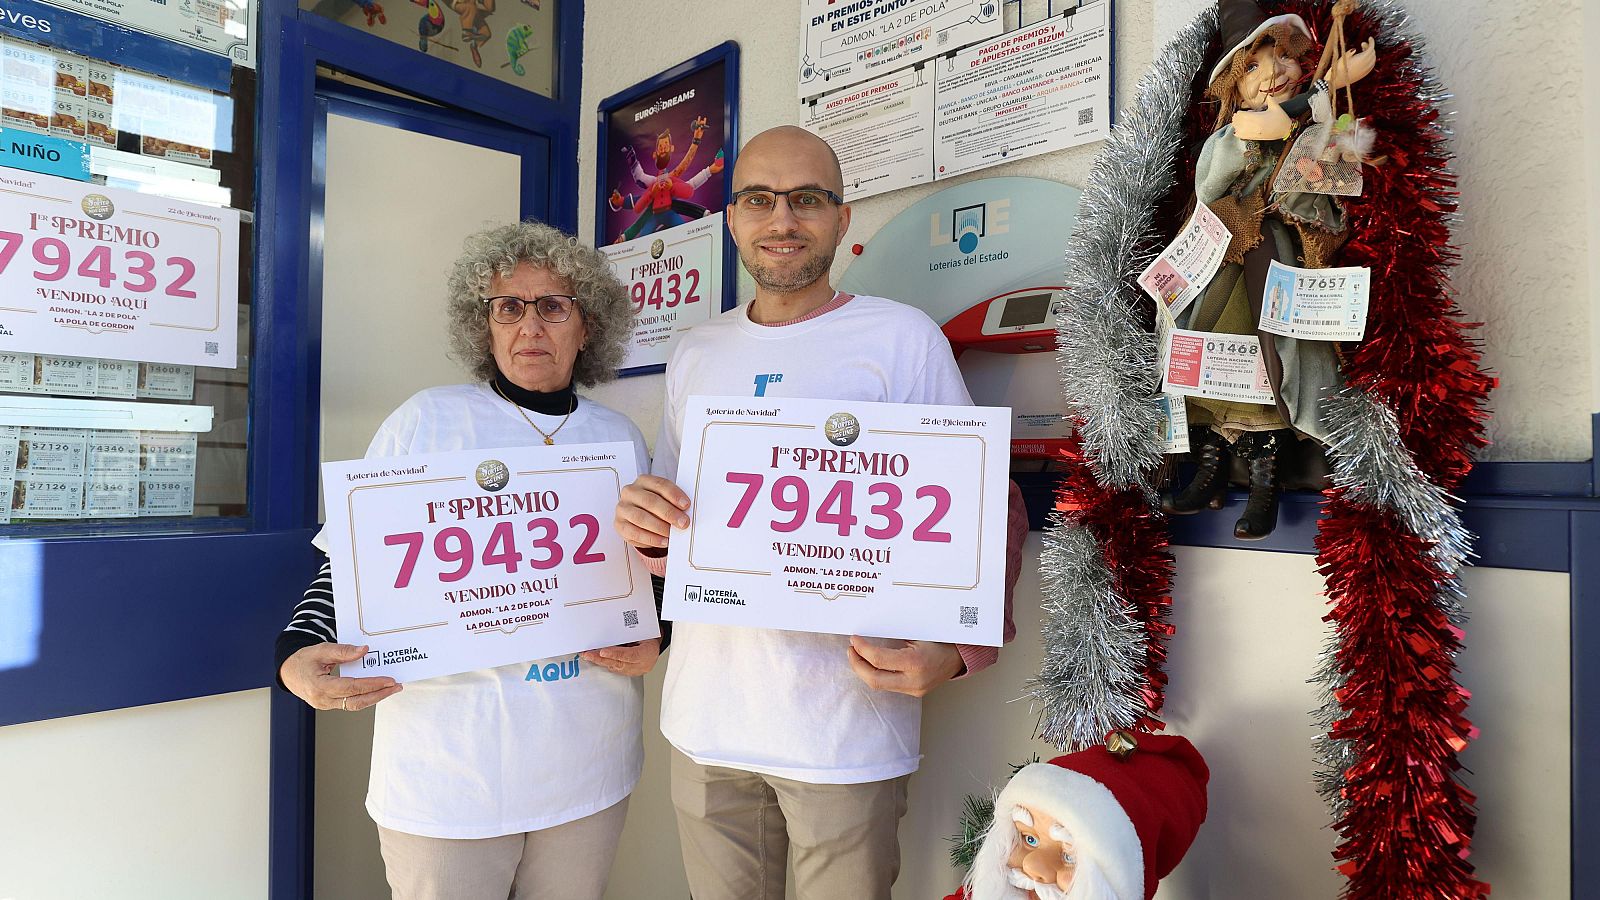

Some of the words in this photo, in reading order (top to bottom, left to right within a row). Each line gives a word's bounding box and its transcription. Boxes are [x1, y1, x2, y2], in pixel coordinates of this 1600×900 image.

[94, 4, 120, 15] GORDON
[812, 15, 825, 26] EN
[828, 0, 873, 21] PREMIOS
[831, 20, 844, 32] EN
[848, 11, 871, 26] ESTE
[874, 0, 906, 18] PUNTO
[841, 29, 876, 47] ADMON.
[880, 22, 894, 33] "LA
[897, 19, 902, 27] 2
[904, 12, 916, 24] DE
[970, 59, 980, 68] DE
[981, 45, 1019, 64] APUESTAS
[1022, 41, 1035, 51] con
[1037, 30, 1064, 45] BIZUM
[978, 43, 998, 56] PAGO
[1001, 39, 1010, 48] DE
[1012, 26, 1048, 44] PREMIOS
[960, 93, 978, 103] BANCO
[1045, 64, 1069, 77] CAJASUR
[1074, 55, 1102, 68] IBERCAJA
[1001, 88, 1020, 98] BANCO
[1021, 77, 1053, 92] SANTANDER
[1060, 66, 1092, 80] BANKINTER
[634, 107, 654, 122] EURO
[662, 88, 696, 110] DREAMS
[825, 99, 843, 110] AVISO
[844, 94, 860, 105] PAGO
[861, 90, 869, 98] DE
[871, 81, 898, 95] PREMIOS
[938, 114, 962, 126] DEUTSCHE
[964, 110, 977, 118] BANK
[982, 103, 1001, 113] GRUPO
[1059, 79, 1079, 90] BANCA
[995, 103, 1027, 116] IMPORTANTE
[12, 142, 61, 161] NIÑO
[51, 216, 159, 248] PREMIO
[1169, 225, 1200, 261] 16726
[0, 230, 196, 298] 79432
[639, 255, 682, 277] PREMIO
[964, 255, 977, 266] del
[979, 250, 1009, 263] Estado
[1155, 274, 1168, 287] UNA
[1299, 278, 1346, 288] 17657
[36, 288, 105, 304] VENDIDO
[110, 297, 146, 310] AQUÍ
[49, 306, 82, 314] ADMON.
[660, 310, 676, 322] AQUÍ
[1206, 342, 1258, 354] 01468
[46, 360, 82, 368] 36797
[770, 446, 789, 468] 1ER
[792, 447, 908, 476] PREMIO
[346, 472, 378, 480] Lotería
[426, 501, 444, 523] 1ER
[448, 490, 558, 520] PREMIO
[726, 472, 951, 542] 79432
[384, 513, 605, 588] 79432
[772, 542, 844, 559] VENDIDO
[849, 546, 890, 564] AQUÍ
[783, 565, 817, 574] ADMON.
[444, 583, 515, 602] VENDIDO
[520, 574, 558, 593] AQUÍ
[704, 589, 737, 597] LOTERÍA
[837, 584, 873, 592] GORDON
[460, 608, 493, 617] ADMON.
[529, 598, 552, 607] POLA"
[703, 596, 745, 605] NACIONAL
[478, 619, 500, 628] POLA
[514, 612, 548, 622] GORDON
[382, 647, 418, 658] LOTERÍA
[383, 653, 427, 664] NACIONAL
[525, 657, 580, 683] AQUÍ
